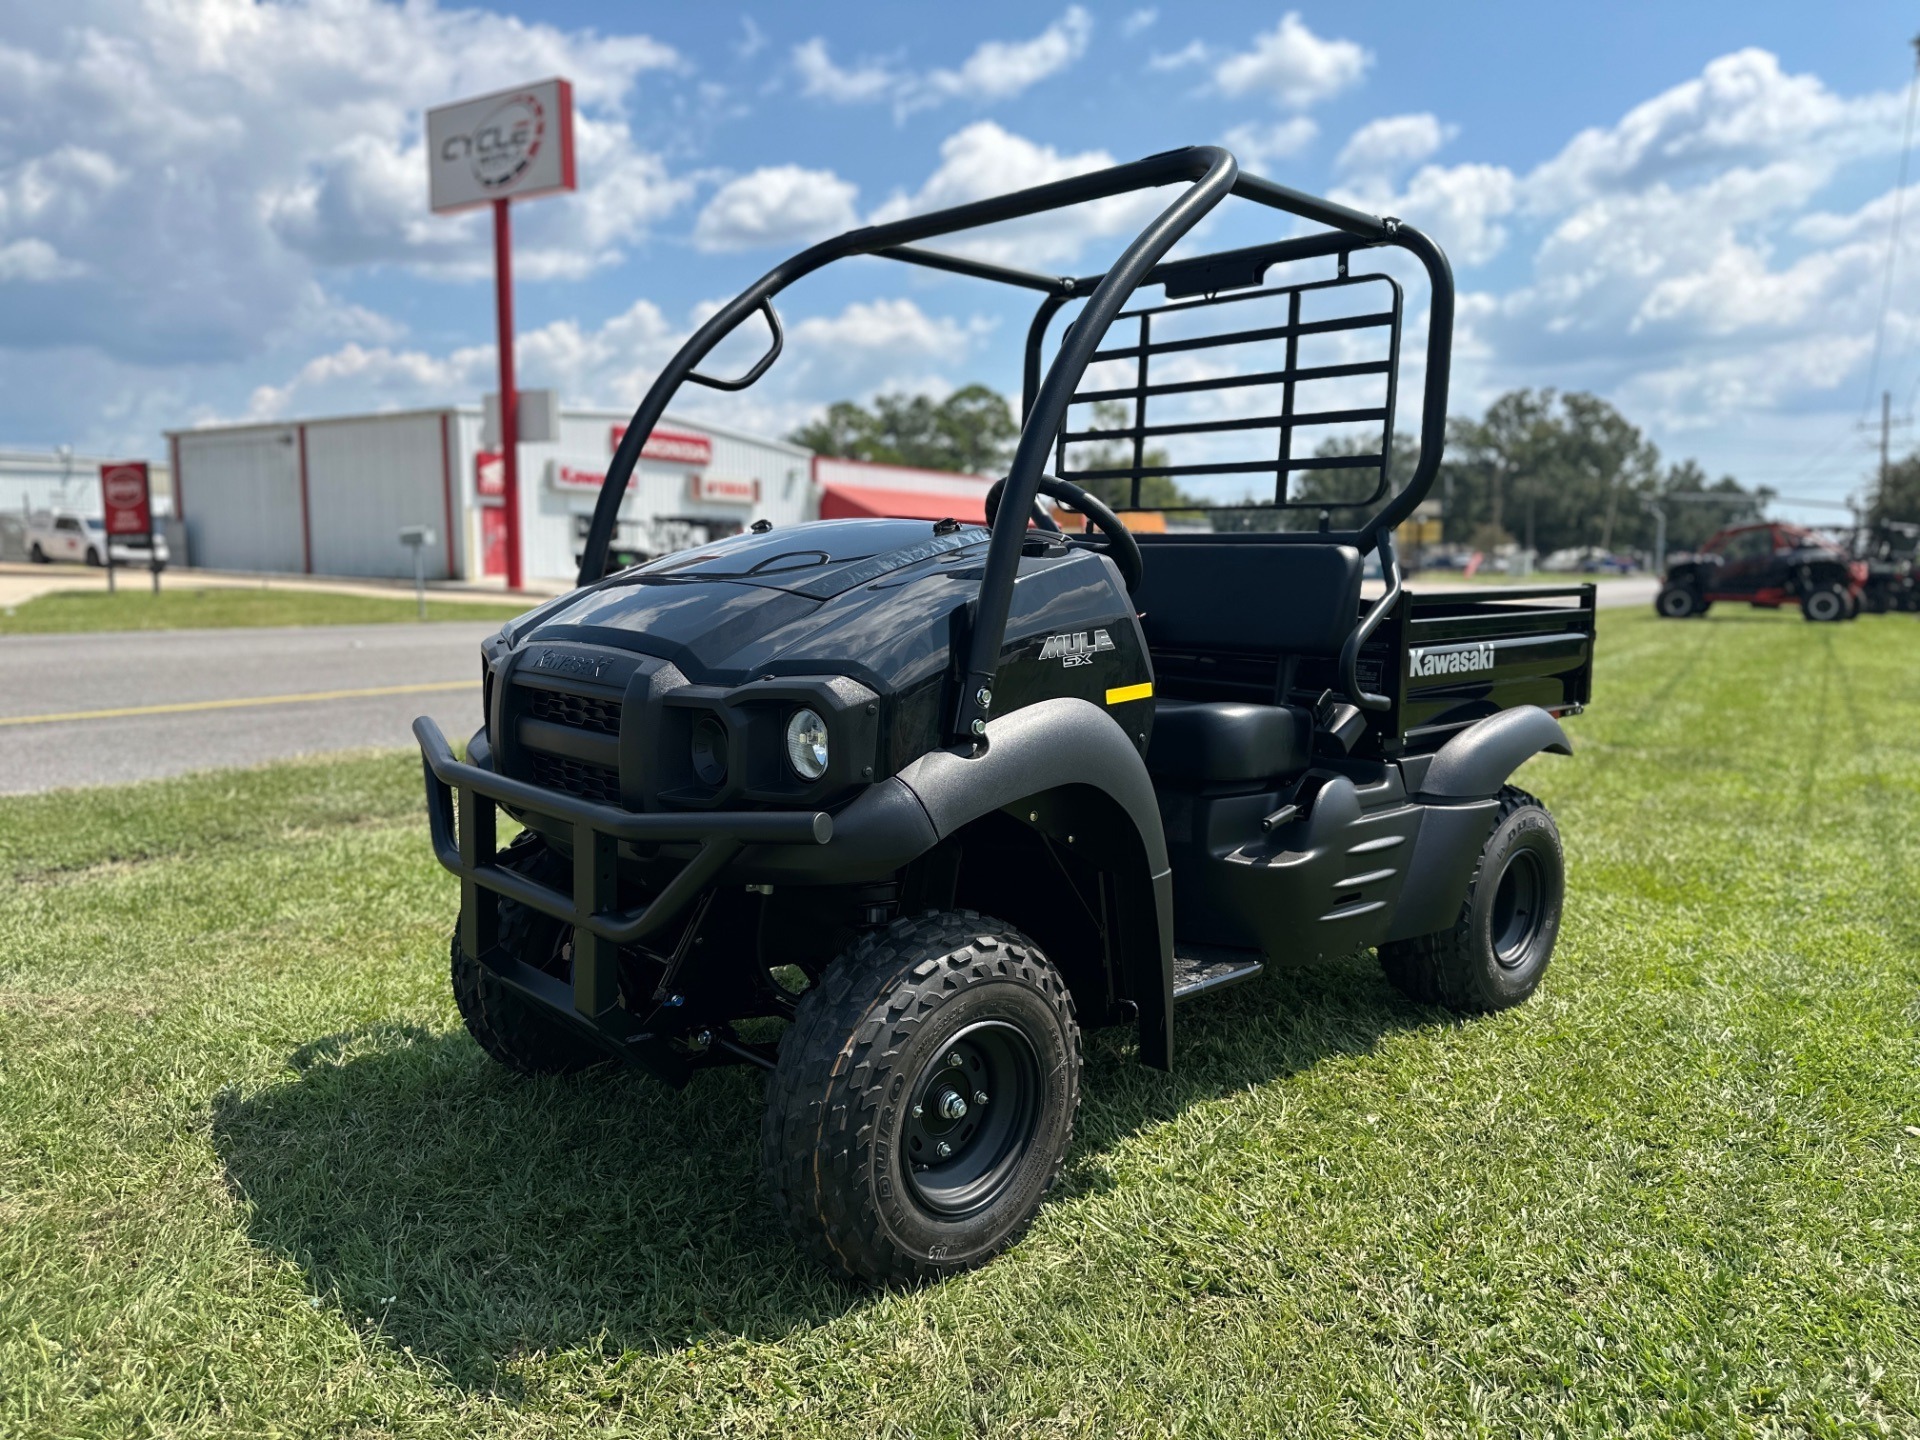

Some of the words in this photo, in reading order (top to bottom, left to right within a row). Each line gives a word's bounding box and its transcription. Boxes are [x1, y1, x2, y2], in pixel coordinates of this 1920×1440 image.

[1038, 629, 1116, 661] MULE
[1063, 652, 1093, 668] SX
[1409, 643, 1495, 678] Kawasaki
[532, 648, 615, 677] Kawasaki
[876, 1072, 906, 1198] DURO
